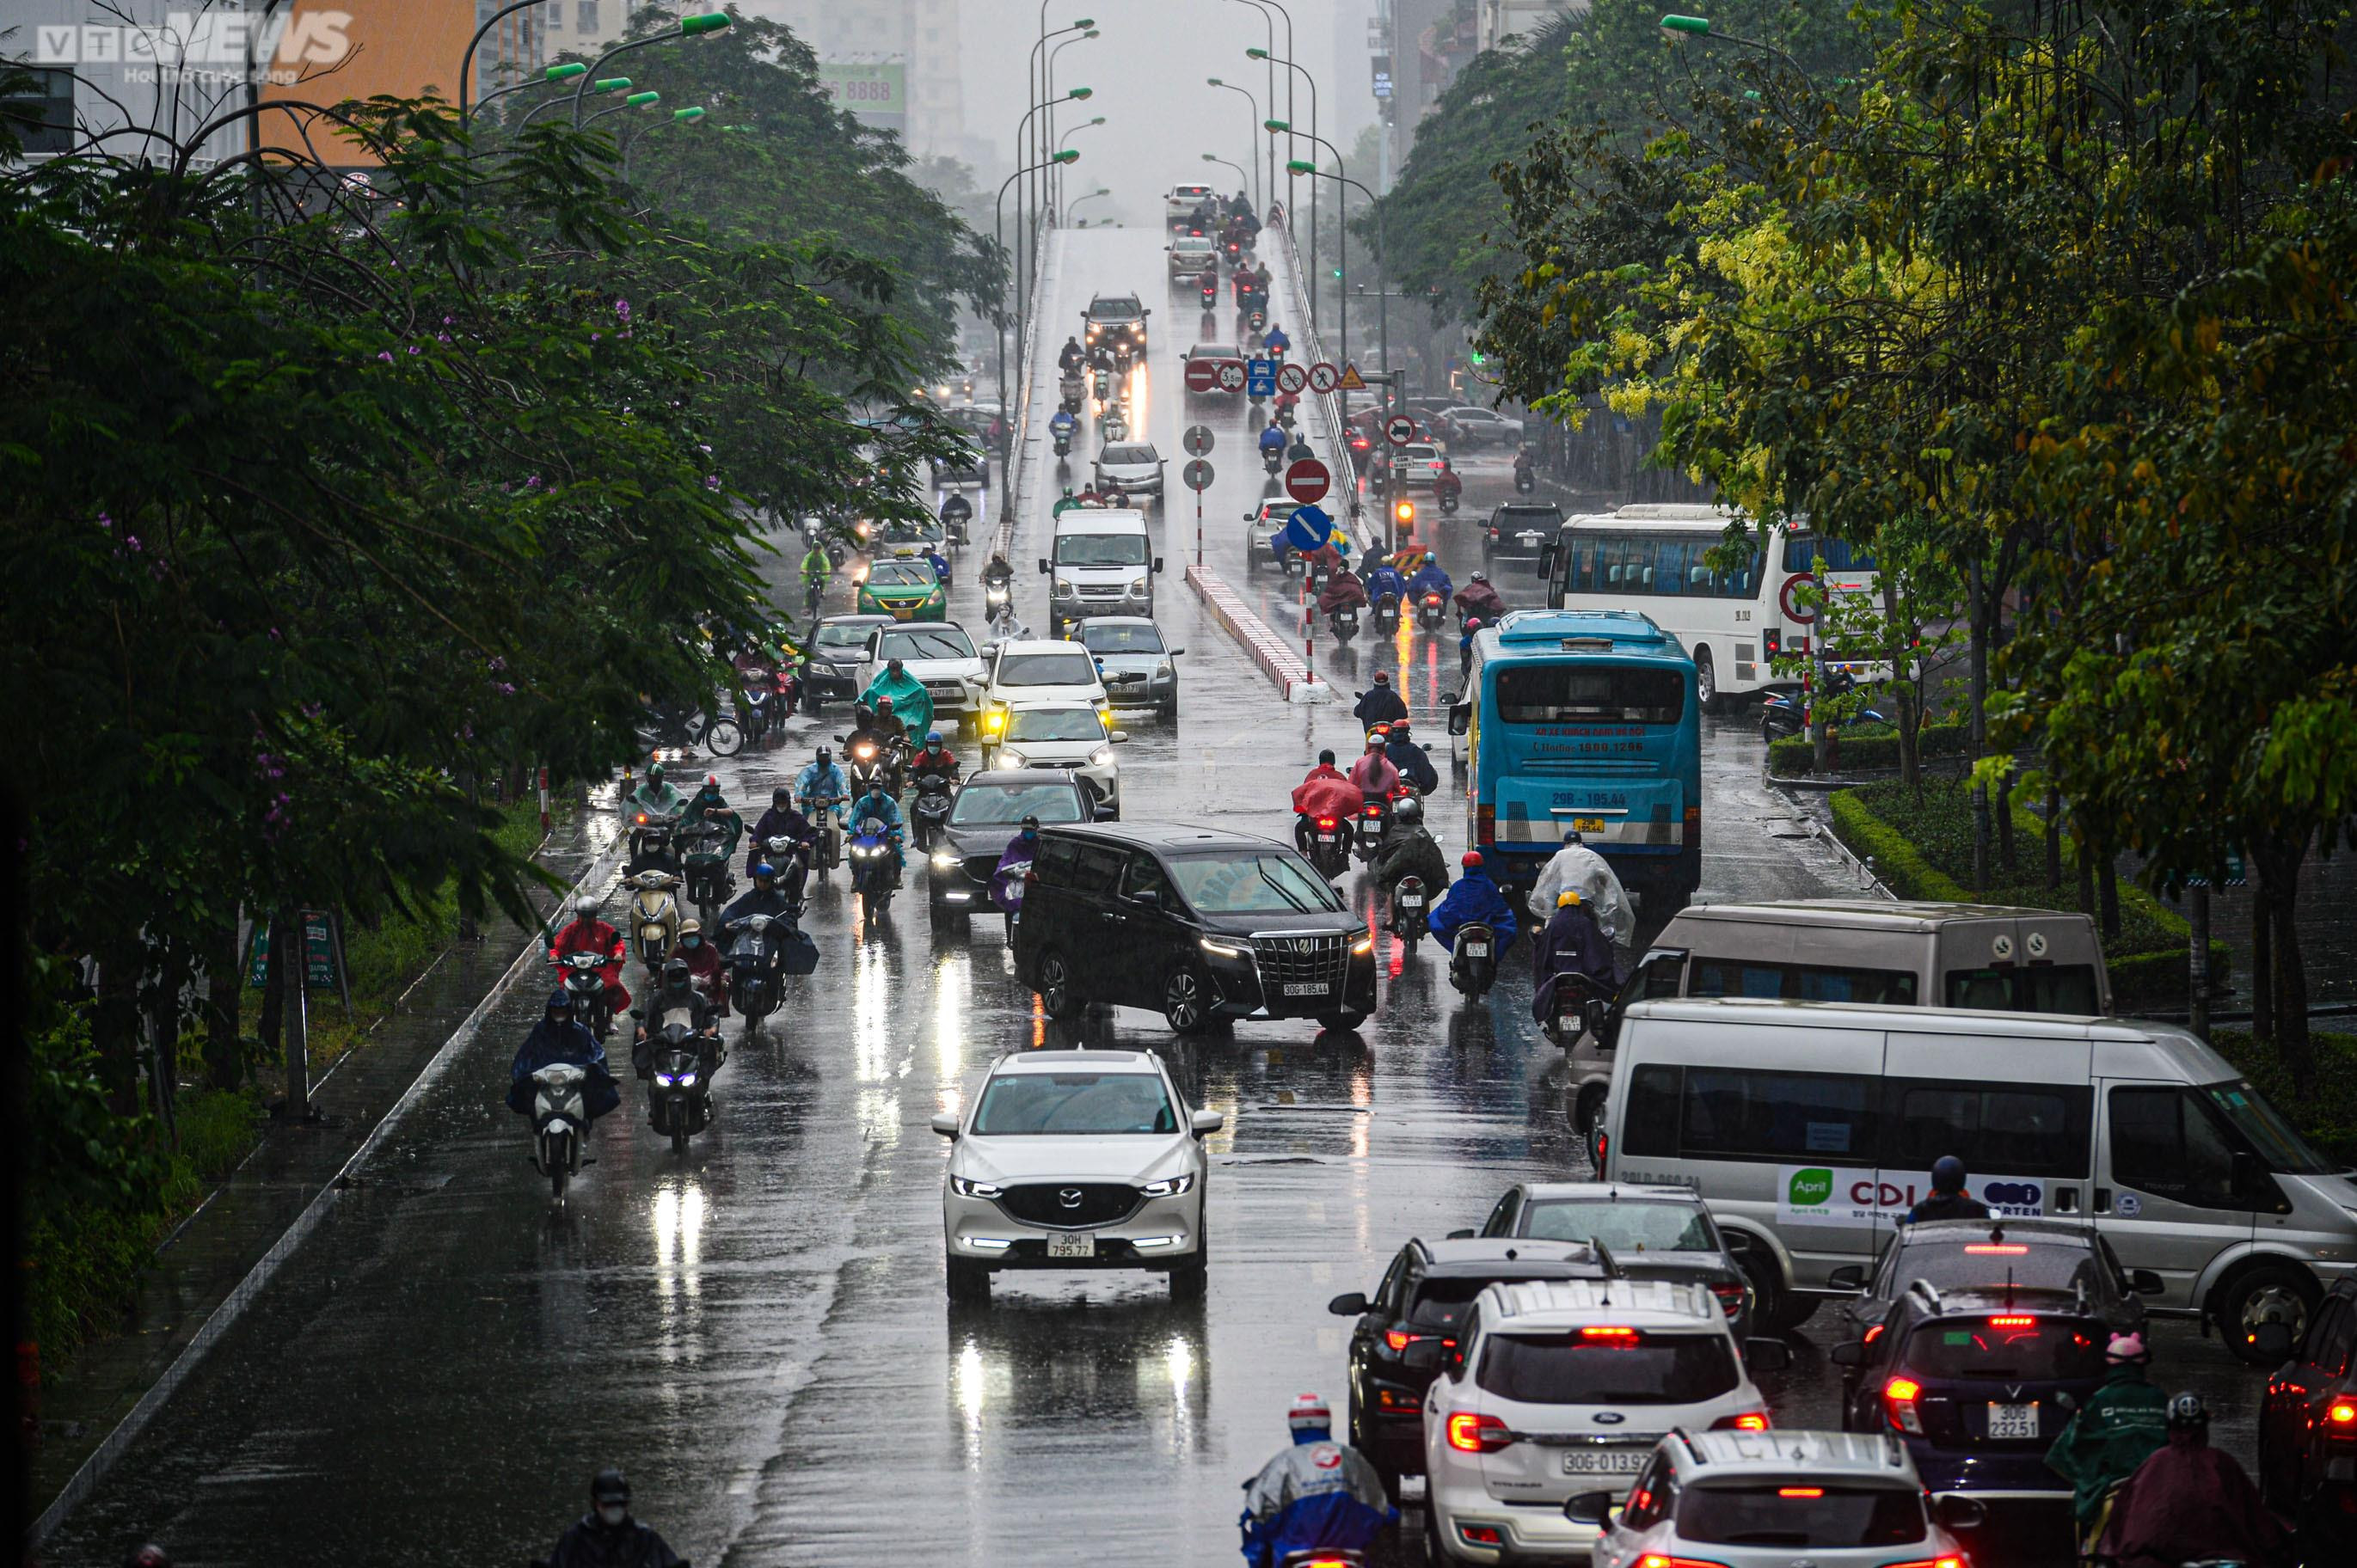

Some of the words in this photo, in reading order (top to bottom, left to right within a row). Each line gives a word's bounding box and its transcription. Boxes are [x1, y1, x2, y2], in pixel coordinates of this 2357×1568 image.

[1794, 1179, 1826, 1195] April
[1850, 1181, 1915, 1207] CDI
[1061, 1234, 1082, 1245] 30H
[1053, 1246, 1089, 1256] 795.77
